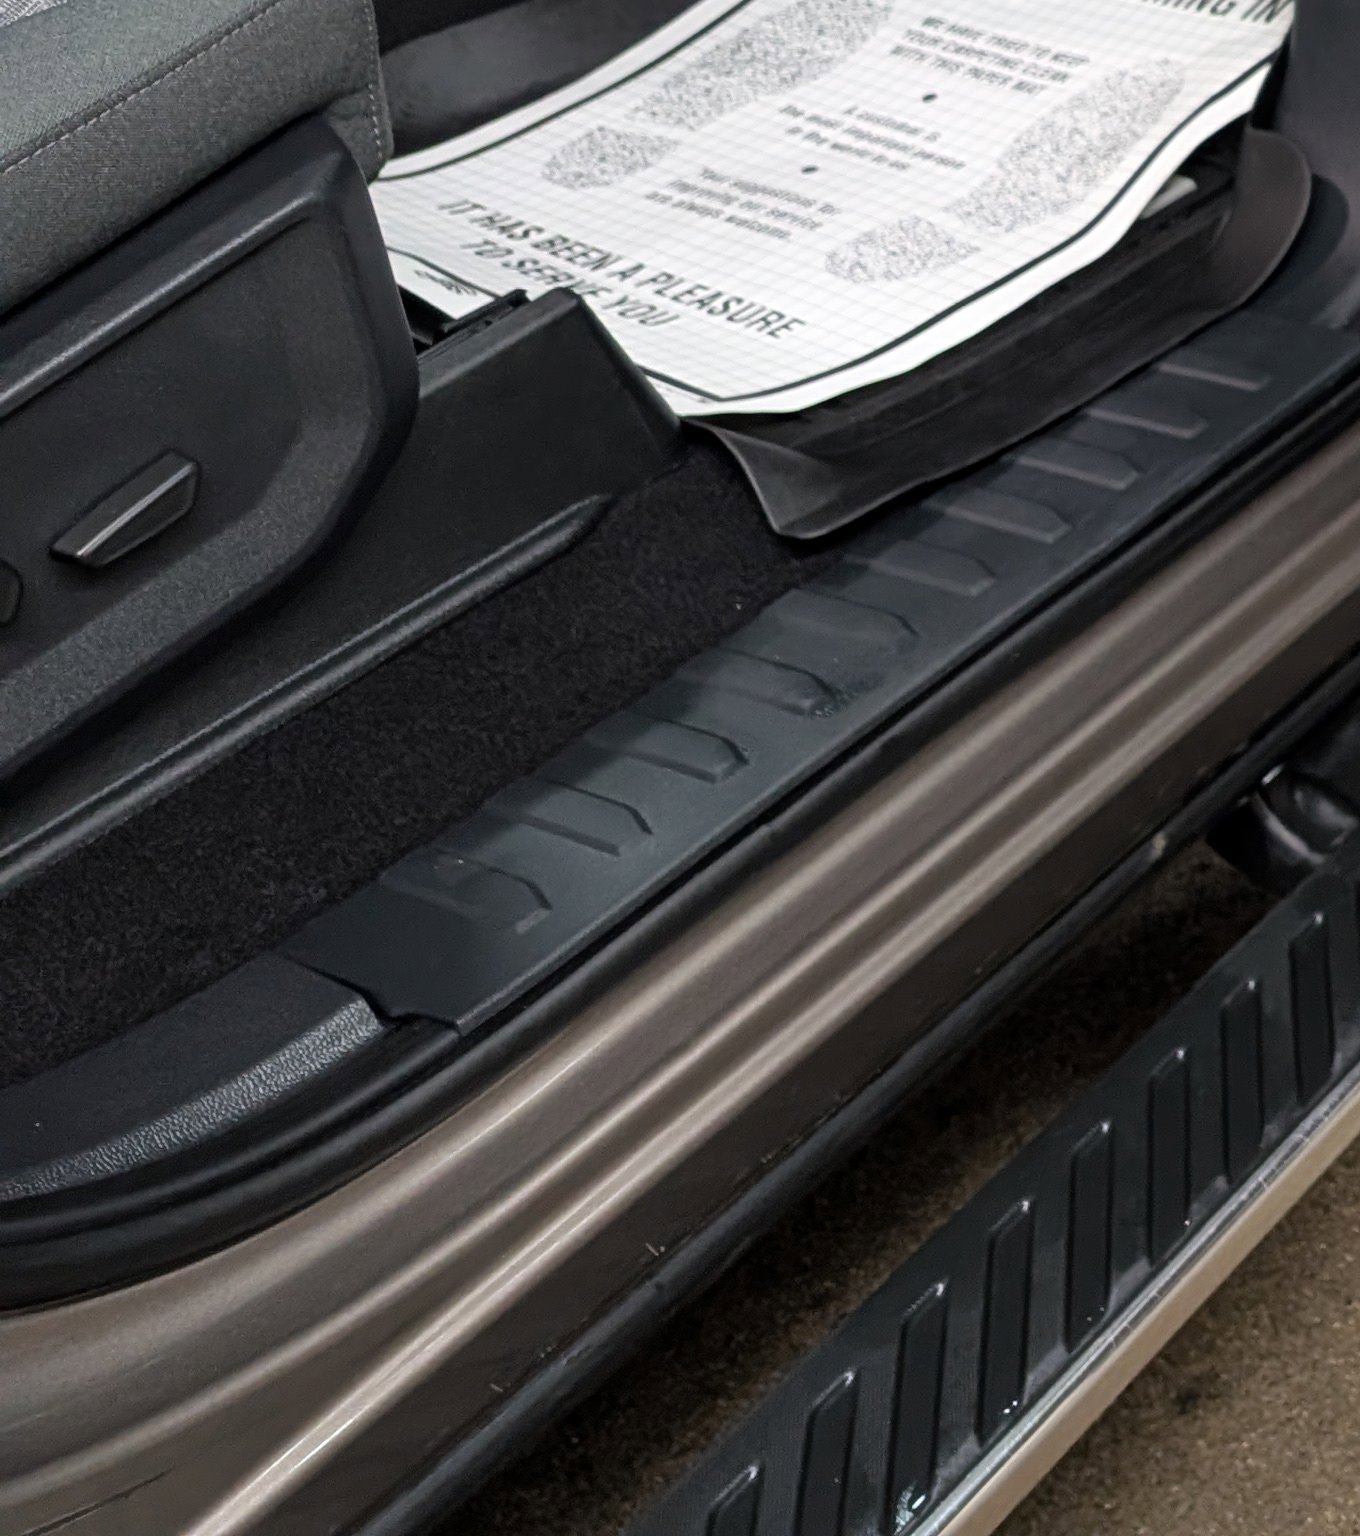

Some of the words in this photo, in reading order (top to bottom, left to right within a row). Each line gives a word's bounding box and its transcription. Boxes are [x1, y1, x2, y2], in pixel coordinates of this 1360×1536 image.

[437, 199, 488, 215] IT
[470, 212, 545, 242] HAS
[531, 233, 624, 271] BEEN
[606, 262, 646, 282] A
[633, 270, 808, 340] PLEASURE
[460, 238, 515, 260] TO
[501, 257, 613, 298] SERVE
[600, 293, 680, 328] YOU
